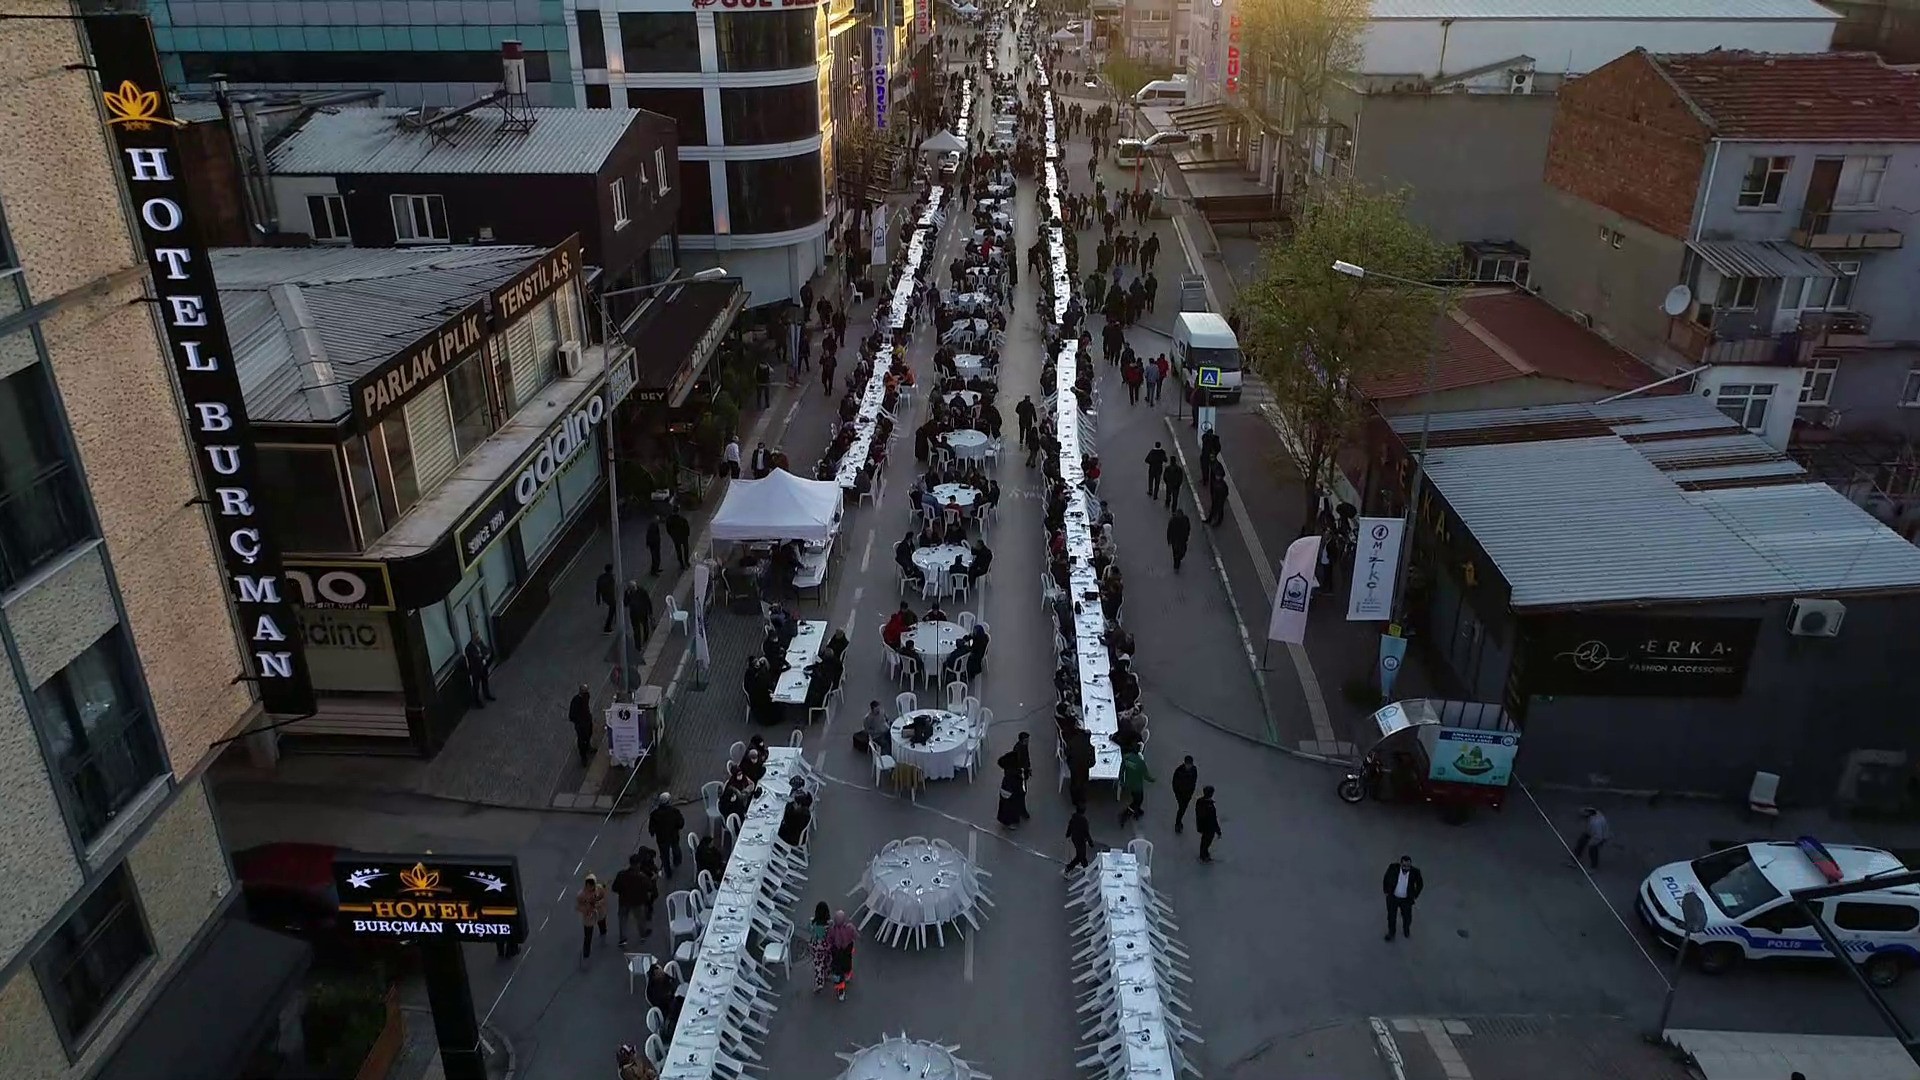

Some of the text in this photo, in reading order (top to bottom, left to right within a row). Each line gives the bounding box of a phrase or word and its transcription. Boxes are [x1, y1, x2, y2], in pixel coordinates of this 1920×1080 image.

[499, 250, 573, 319] TEKSTİL A.Ş.
[362, 313, 482, 418] PARLAK İPLİK
[640, 392, 665, 401] BEY
[124, 146, 293, 679] HOTEL BURÇMAN
[514, 395, 604, 505] addino
[467, 525, 491, 555] SINCE
[1628, 663, 1668, 673] FASHION
[372, 900, 478, 920] HOTEL
[353, 919, 511, 938] BURÇMAN VİŞNE
